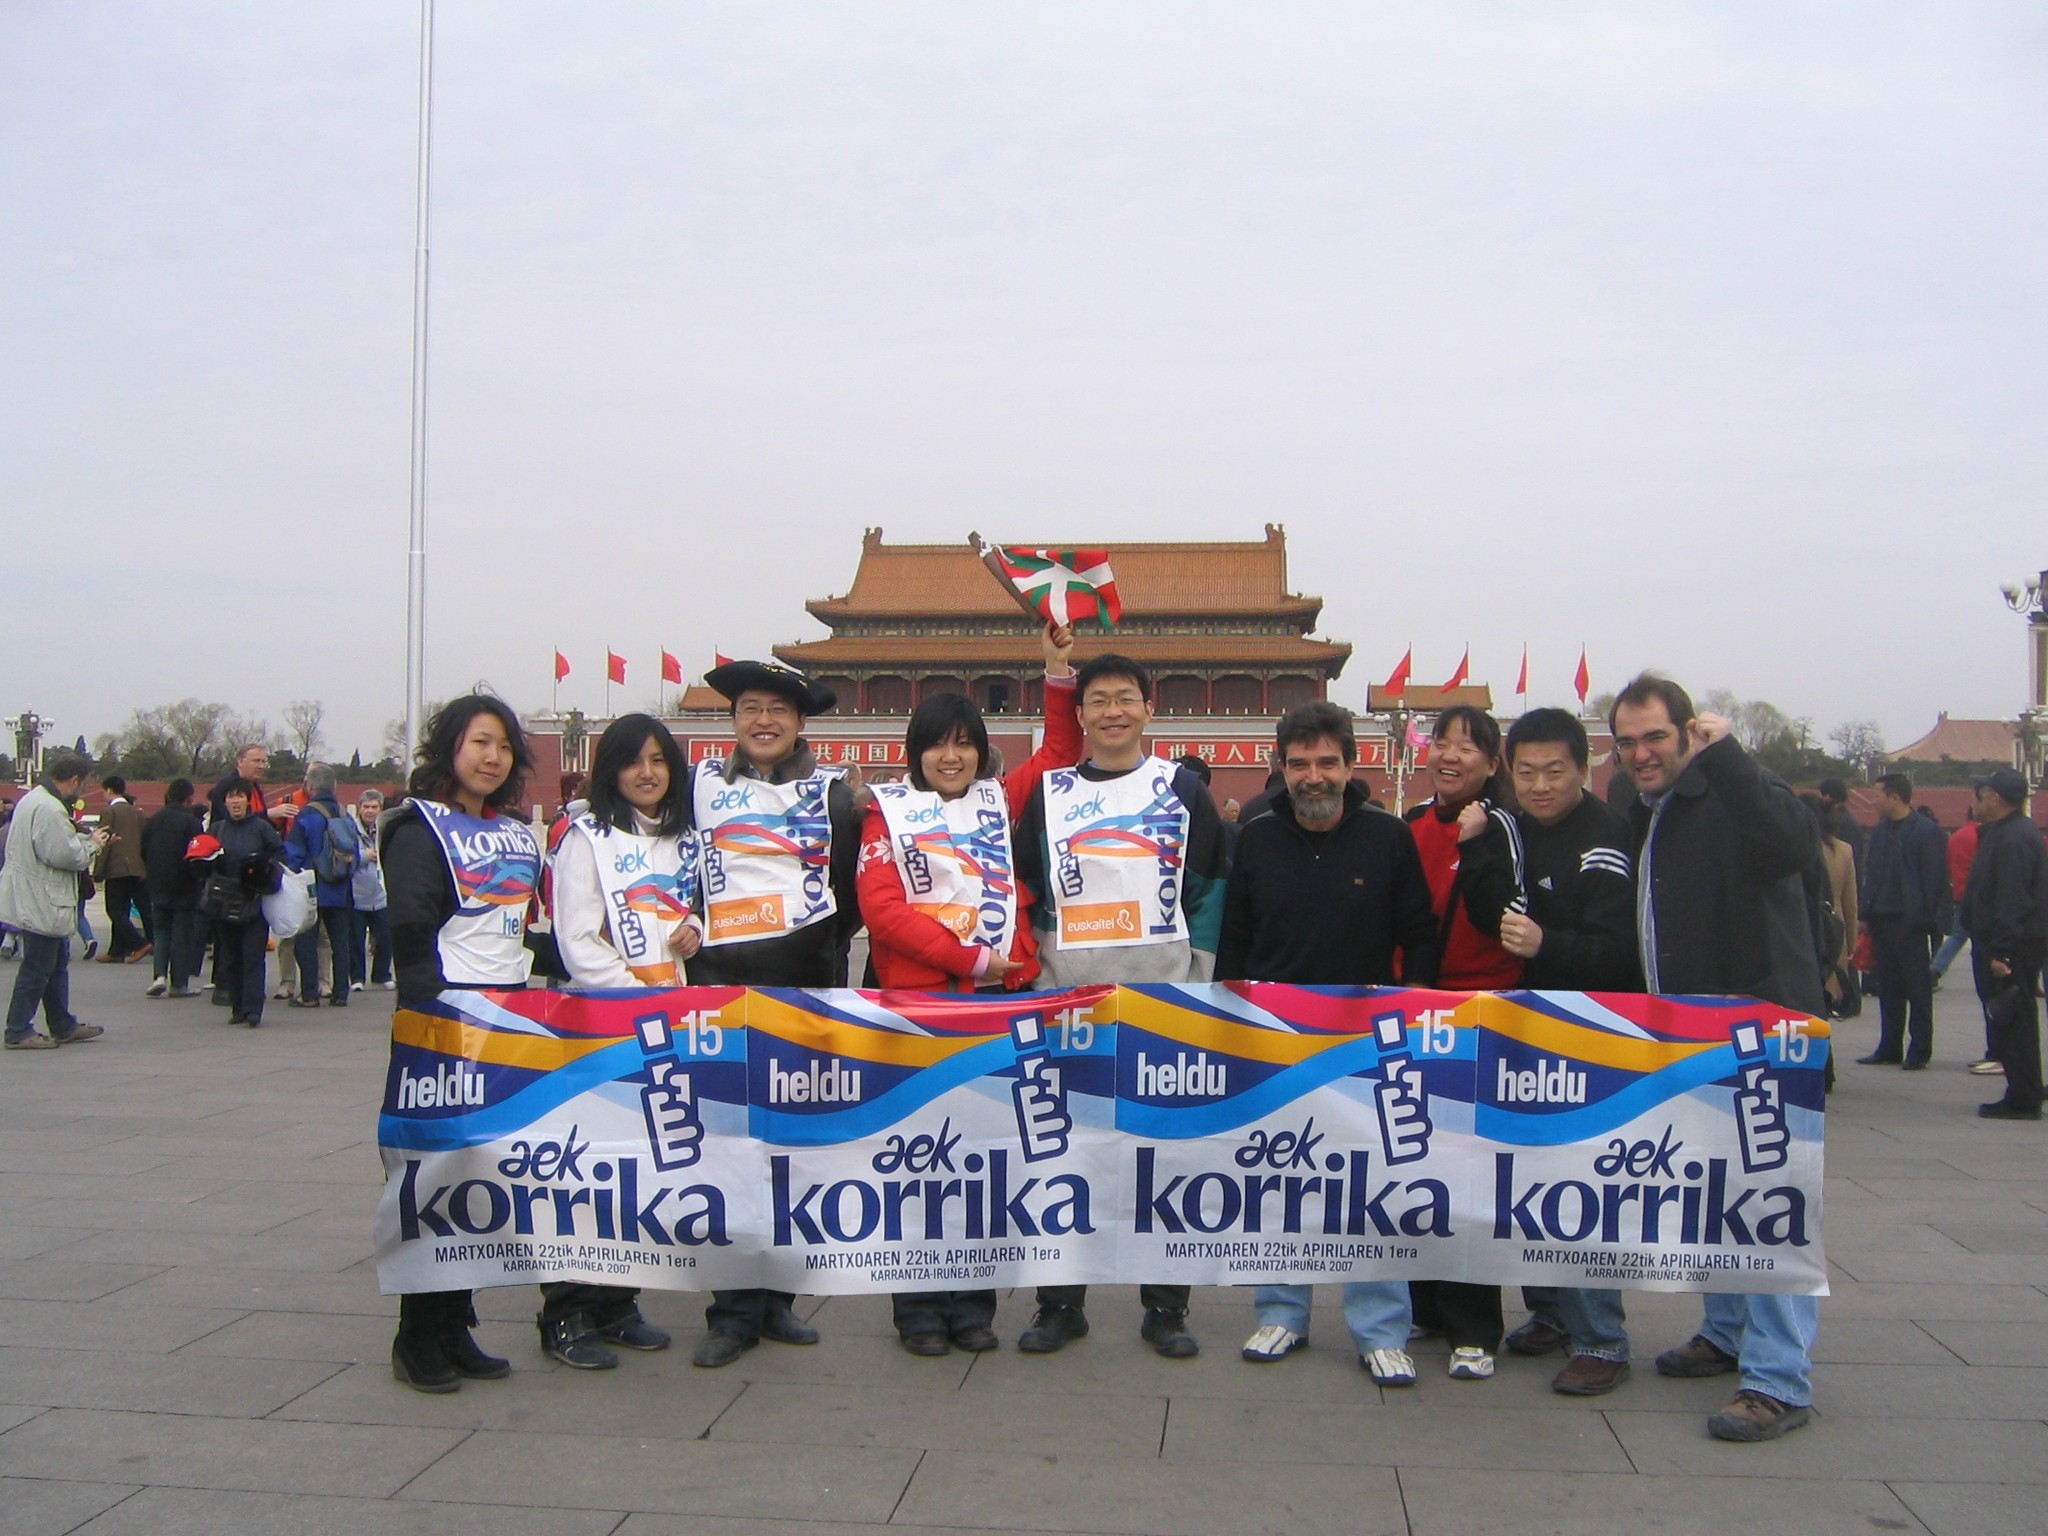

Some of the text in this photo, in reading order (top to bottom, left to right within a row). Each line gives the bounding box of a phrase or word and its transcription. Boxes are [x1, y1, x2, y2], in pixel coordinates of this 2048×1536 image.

[710, 783, 754, 811] aek
[904, 798, 945, 823] aek
[977, 787, 996, 805] 15
[1064, 790, 1106, 822] aek
[449, 823, 537, 865] korrika
[614, 844, 650, 873] aek
[503, 911, 525, 936] hel
[712, 911, 759, 929] euskaltel
[1067, 917, 1115, 932] euskaltel
[680, 1010, 723, 1056] 15
[1054, 1007, 1095, 1051] 15
[1415, 1008, 1456, 1054] 15
[1772, 1019, 1810, 1064] 15
[397, 1061, 485, 1110] heldu
[769, 1058, 861, 1104] heldu
[1137, 1052, 1227, 1097] heldu
[1497, 1058, 1587, 1104] heldu
[498, 1123, 590, 1182] aek
[872, 1117, 962, 1175] aek
[1234, 1116, 1325, 1171] aek
[1593, 1123, 1684, 1180] aek
[399, 1157, 733, 1247] korrika
[770, 1149, 1097, 1247] korrika
[1134, 1146, 1455, 1238] korrika
[1493, 1152, 1811, 1247] korrika
[435, 1243, 697, 1268] MARTXOAREN 22tik APIRILAREN 1era
[503, 1259, 631, 1275] KARRANTZA-IRUÑEA 2007
[805, 1246, 1061, 1270] MARTXOAREN 22tik APIRILAREN 1era
[1165, 1242, 1417, 1260] MARTXOAREN 22tik APIRILAREN 1era
[1229, 1258, 1353, 1272] KARRANTZA-IRUÑEA 2007
[1522, 1249, 1774, 1271] MARTXOAREN 22tik APIRILAREN 1era
[870, 1265, 996, 1282] KARRANTZA-IRUÑEA 2007
[1585, 1268, 1710, 1282] KARRANTZA-IRUÑEA 2007
